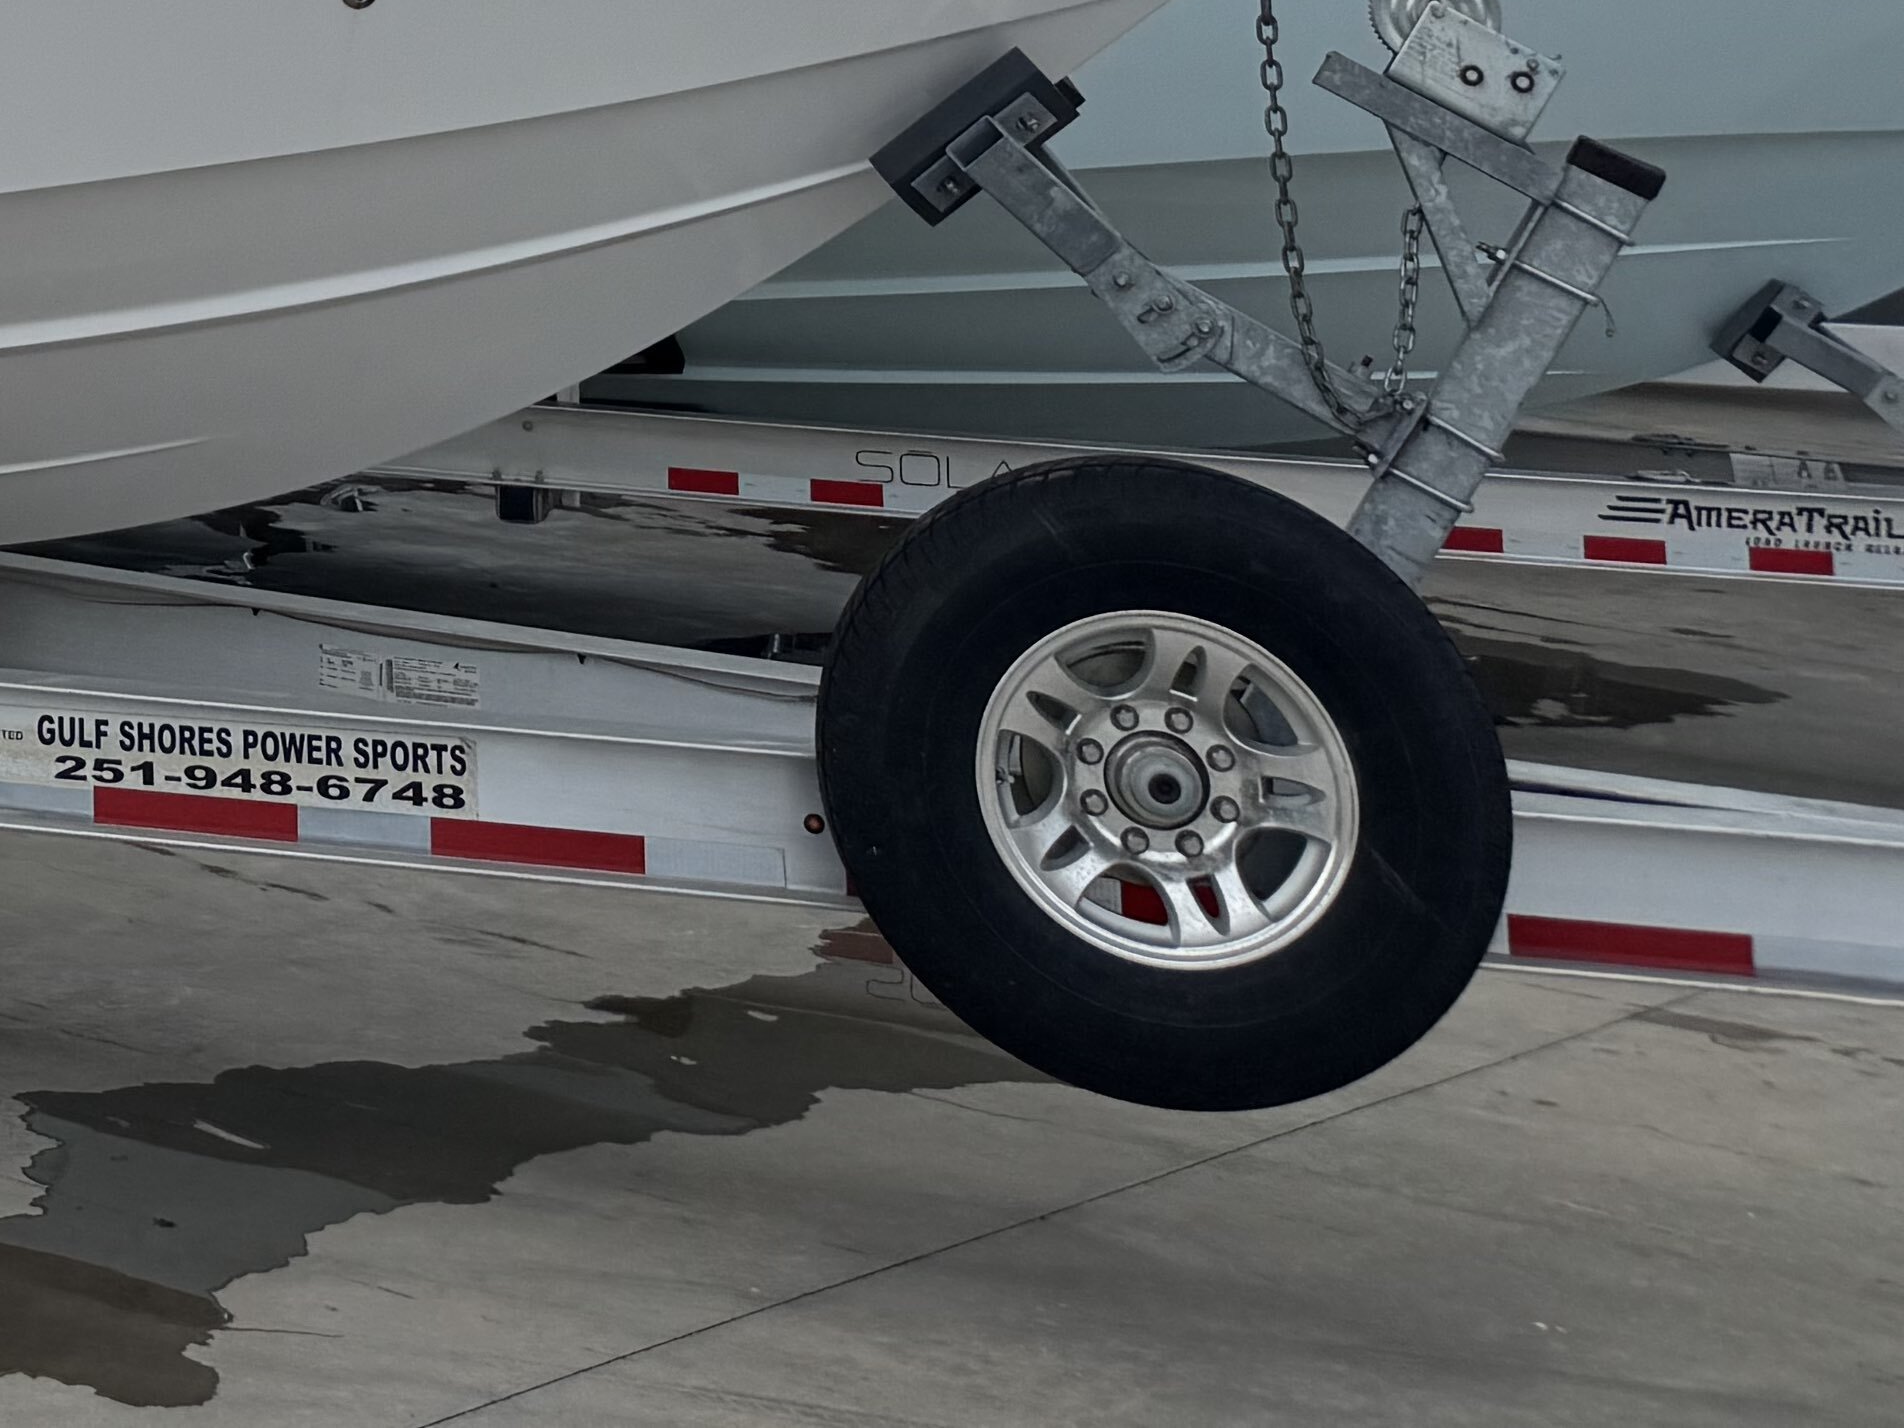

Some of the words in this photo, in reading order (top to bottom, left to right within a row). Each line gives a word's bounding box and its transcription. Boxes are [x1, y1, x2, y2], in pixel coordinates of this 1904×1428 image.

[37, 714, 109, 750] GULF
[119, 721, 232, 759] SHORES
[242, 727, 345, 768] POWER
[353, 736, 467, 777] SPORTS
[54, 755, 466, 810] 251-948-6748
